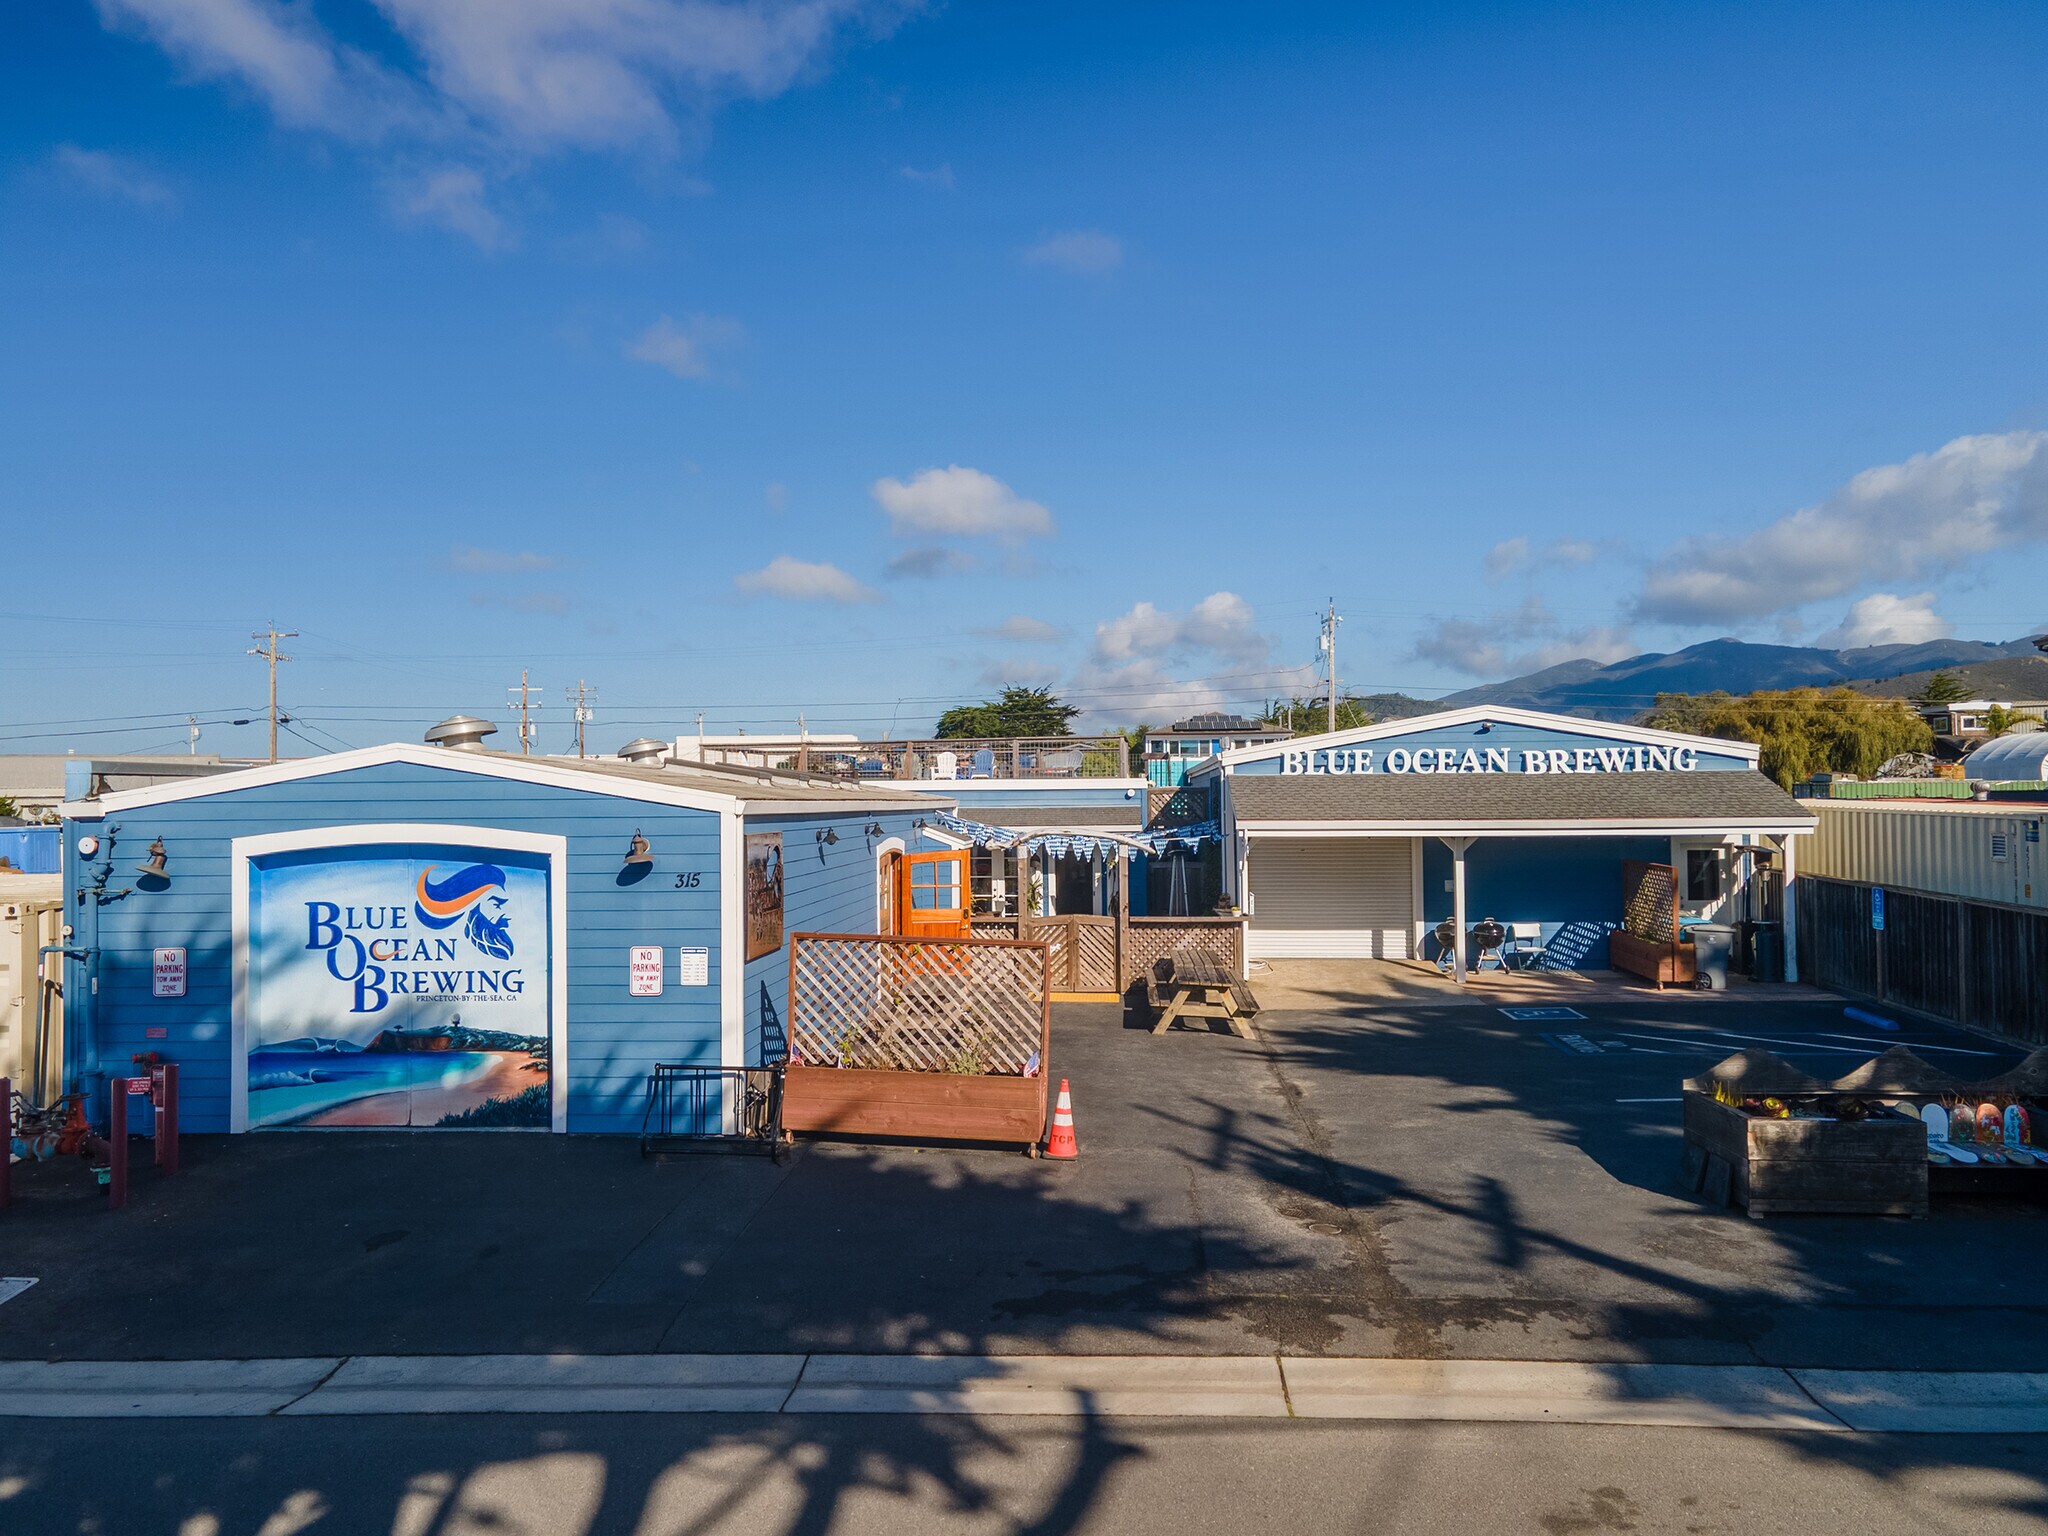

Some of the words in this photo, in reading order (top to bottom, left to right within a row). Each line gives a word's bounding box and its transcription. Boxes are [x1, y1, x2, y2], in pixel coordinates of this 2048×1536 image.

[1280, 749, 1374, 776] BLUE
[1387, 747, 1510, 774] OCEAN
[1523, 746, 1699, 775] BREWING
[675, 872, 701, 888] 315
[304, 901, 408, 949] BLUE
[163, 952, 176, 962] NO
[326, 934, 457, 981] OCEAN
[640, 951, 653, 961] NO
[156, 964, 184, 974] PARKING
[632, 963, 660, 972] PARKING
[162, 984, 177, 992] ZONE
[350, 964, 525, 1013] BREWING
[506, 994, 517, 1002] CA
[1053, 1134, 1073, 1145] TCP
